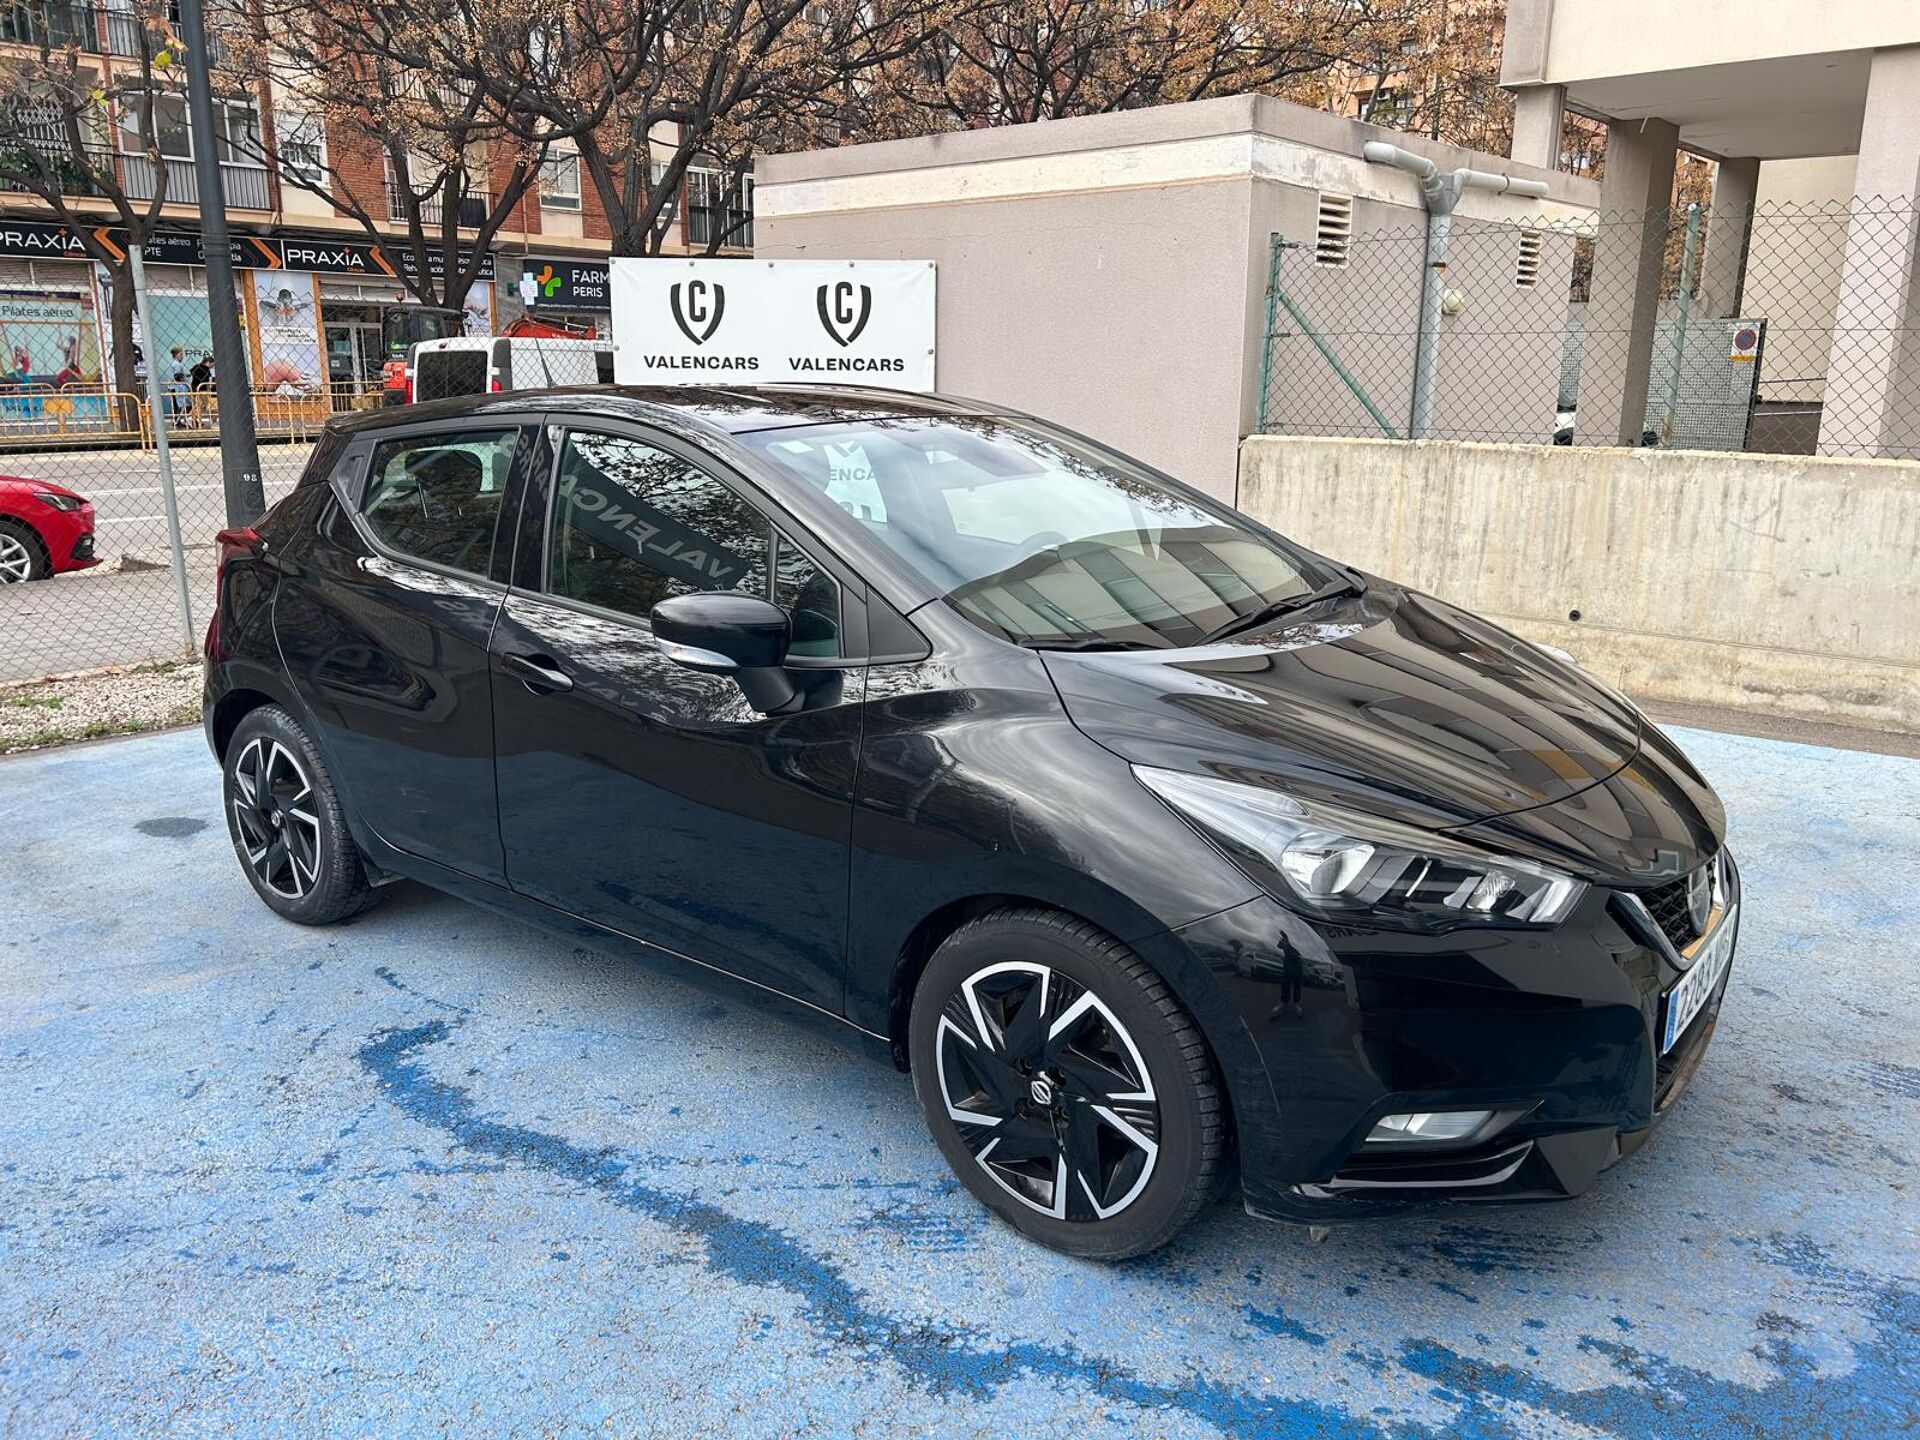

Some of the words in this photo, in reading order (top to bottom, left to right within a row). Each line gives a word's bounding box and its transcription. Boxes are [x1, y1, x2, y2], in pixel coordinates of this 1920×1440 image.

[572, 286, 603, 298] PERIS
[1, 305, 41, 317] Pilates
[43, 307, 74, 318] aéreo
[643, 355, 760, 370] VALENCARS
[789, 357, 905, 372] VALENCARS
